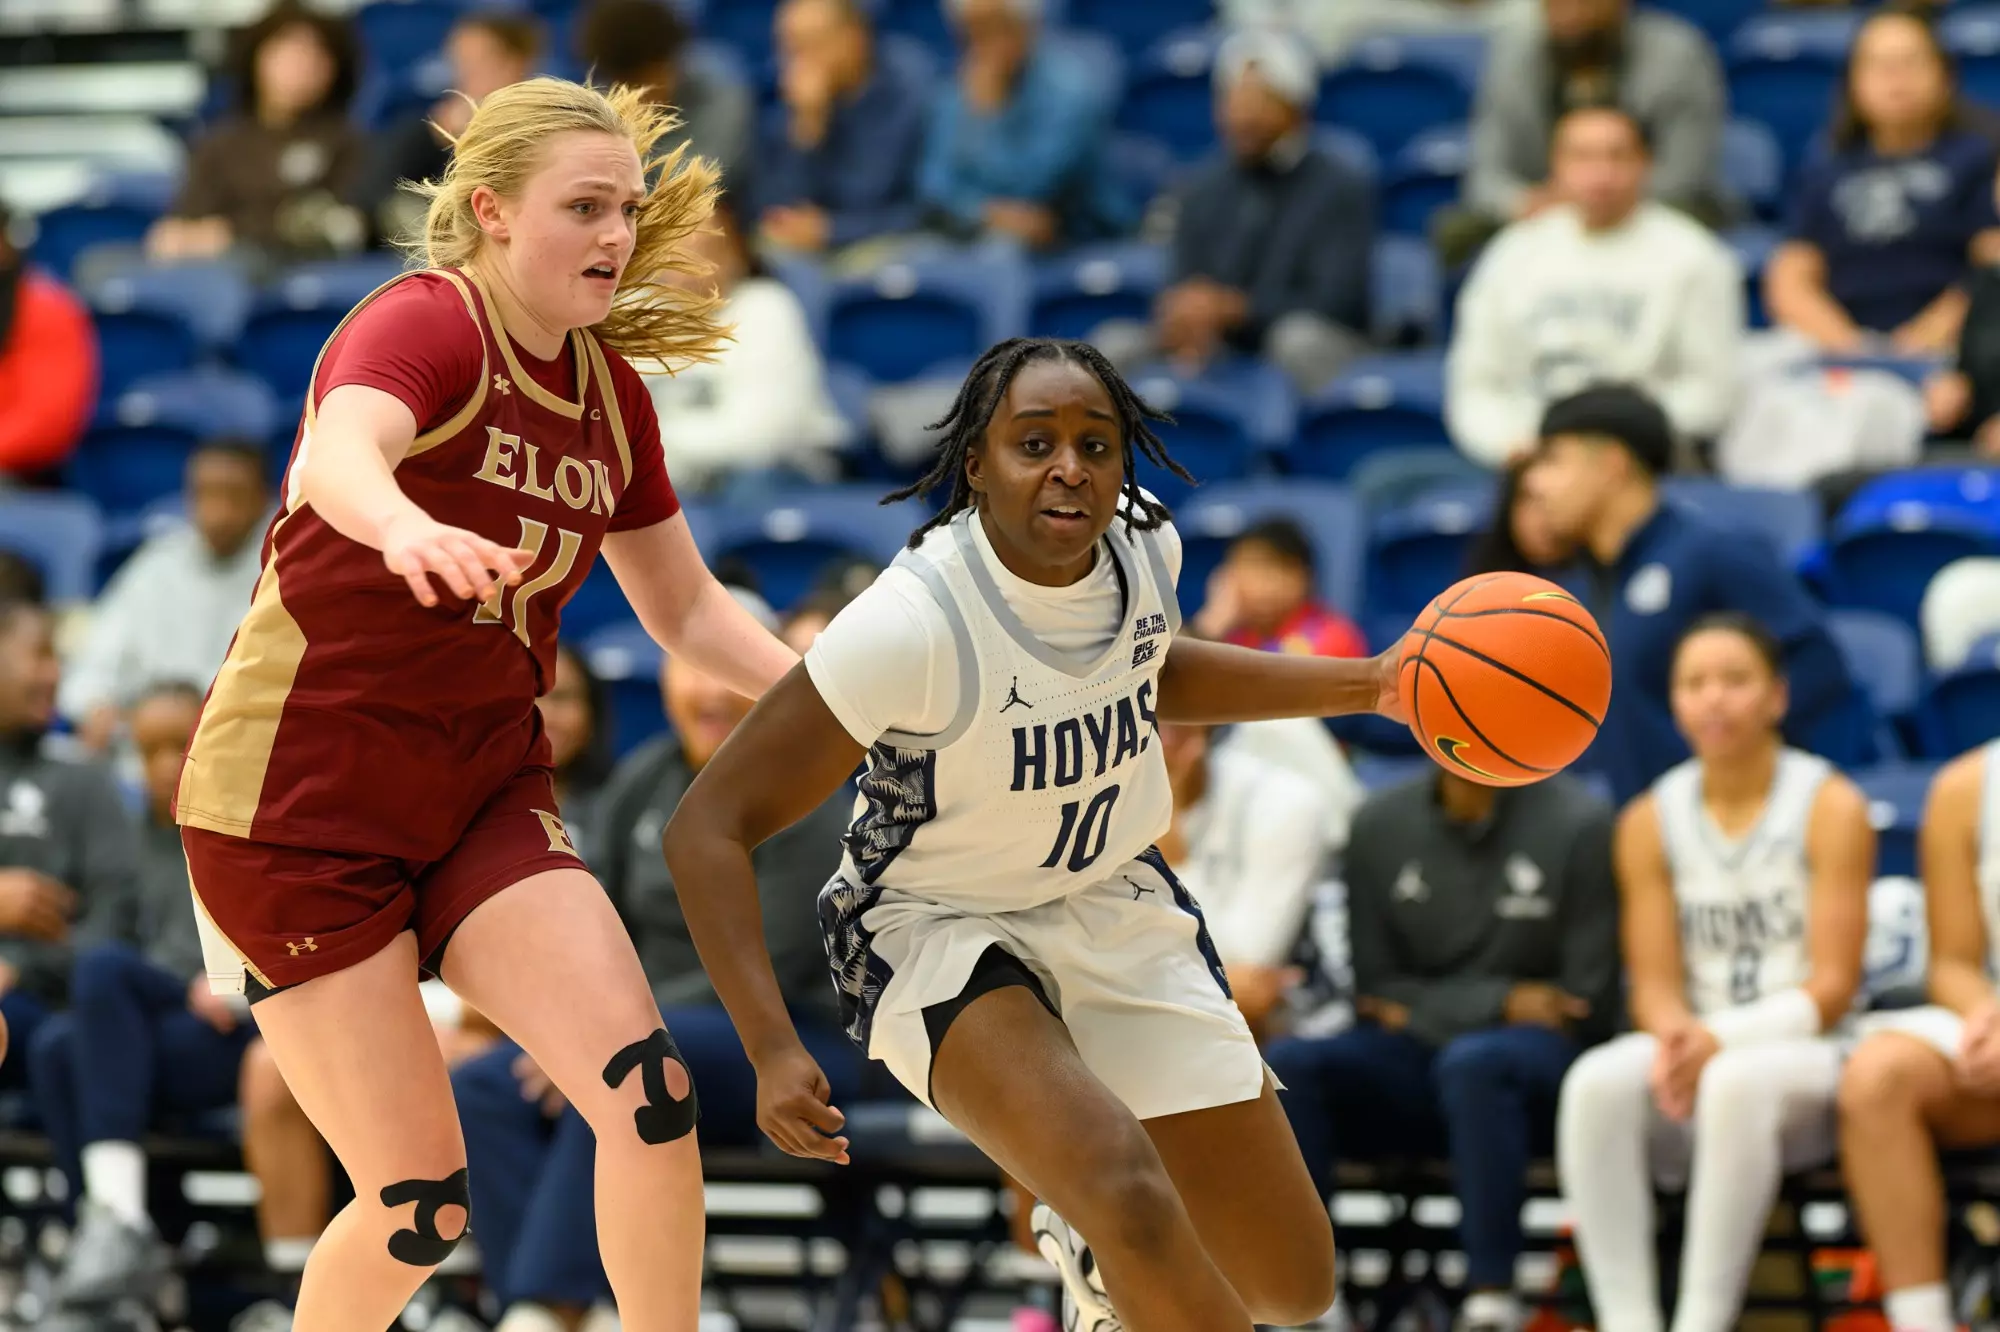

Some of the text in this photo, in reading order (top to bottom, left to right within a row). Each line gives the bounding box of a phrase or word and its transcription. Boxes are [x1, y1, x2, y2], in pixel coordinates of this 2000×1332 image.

[472, 425, 616, 518] ELON
[472, 515, 583, 648] 11
[1133, 622, 1167, 641] CHANGE
[1133, 639, 1155, 656] BIG
[1135, 617, 1149, 630] BE
[1131, 644, 1160, 665] EAST
[1009, 678, 1156, 791] HOYAS
[528, 808, 582, 861] E
[1037, 783, 1120, 873] 10
